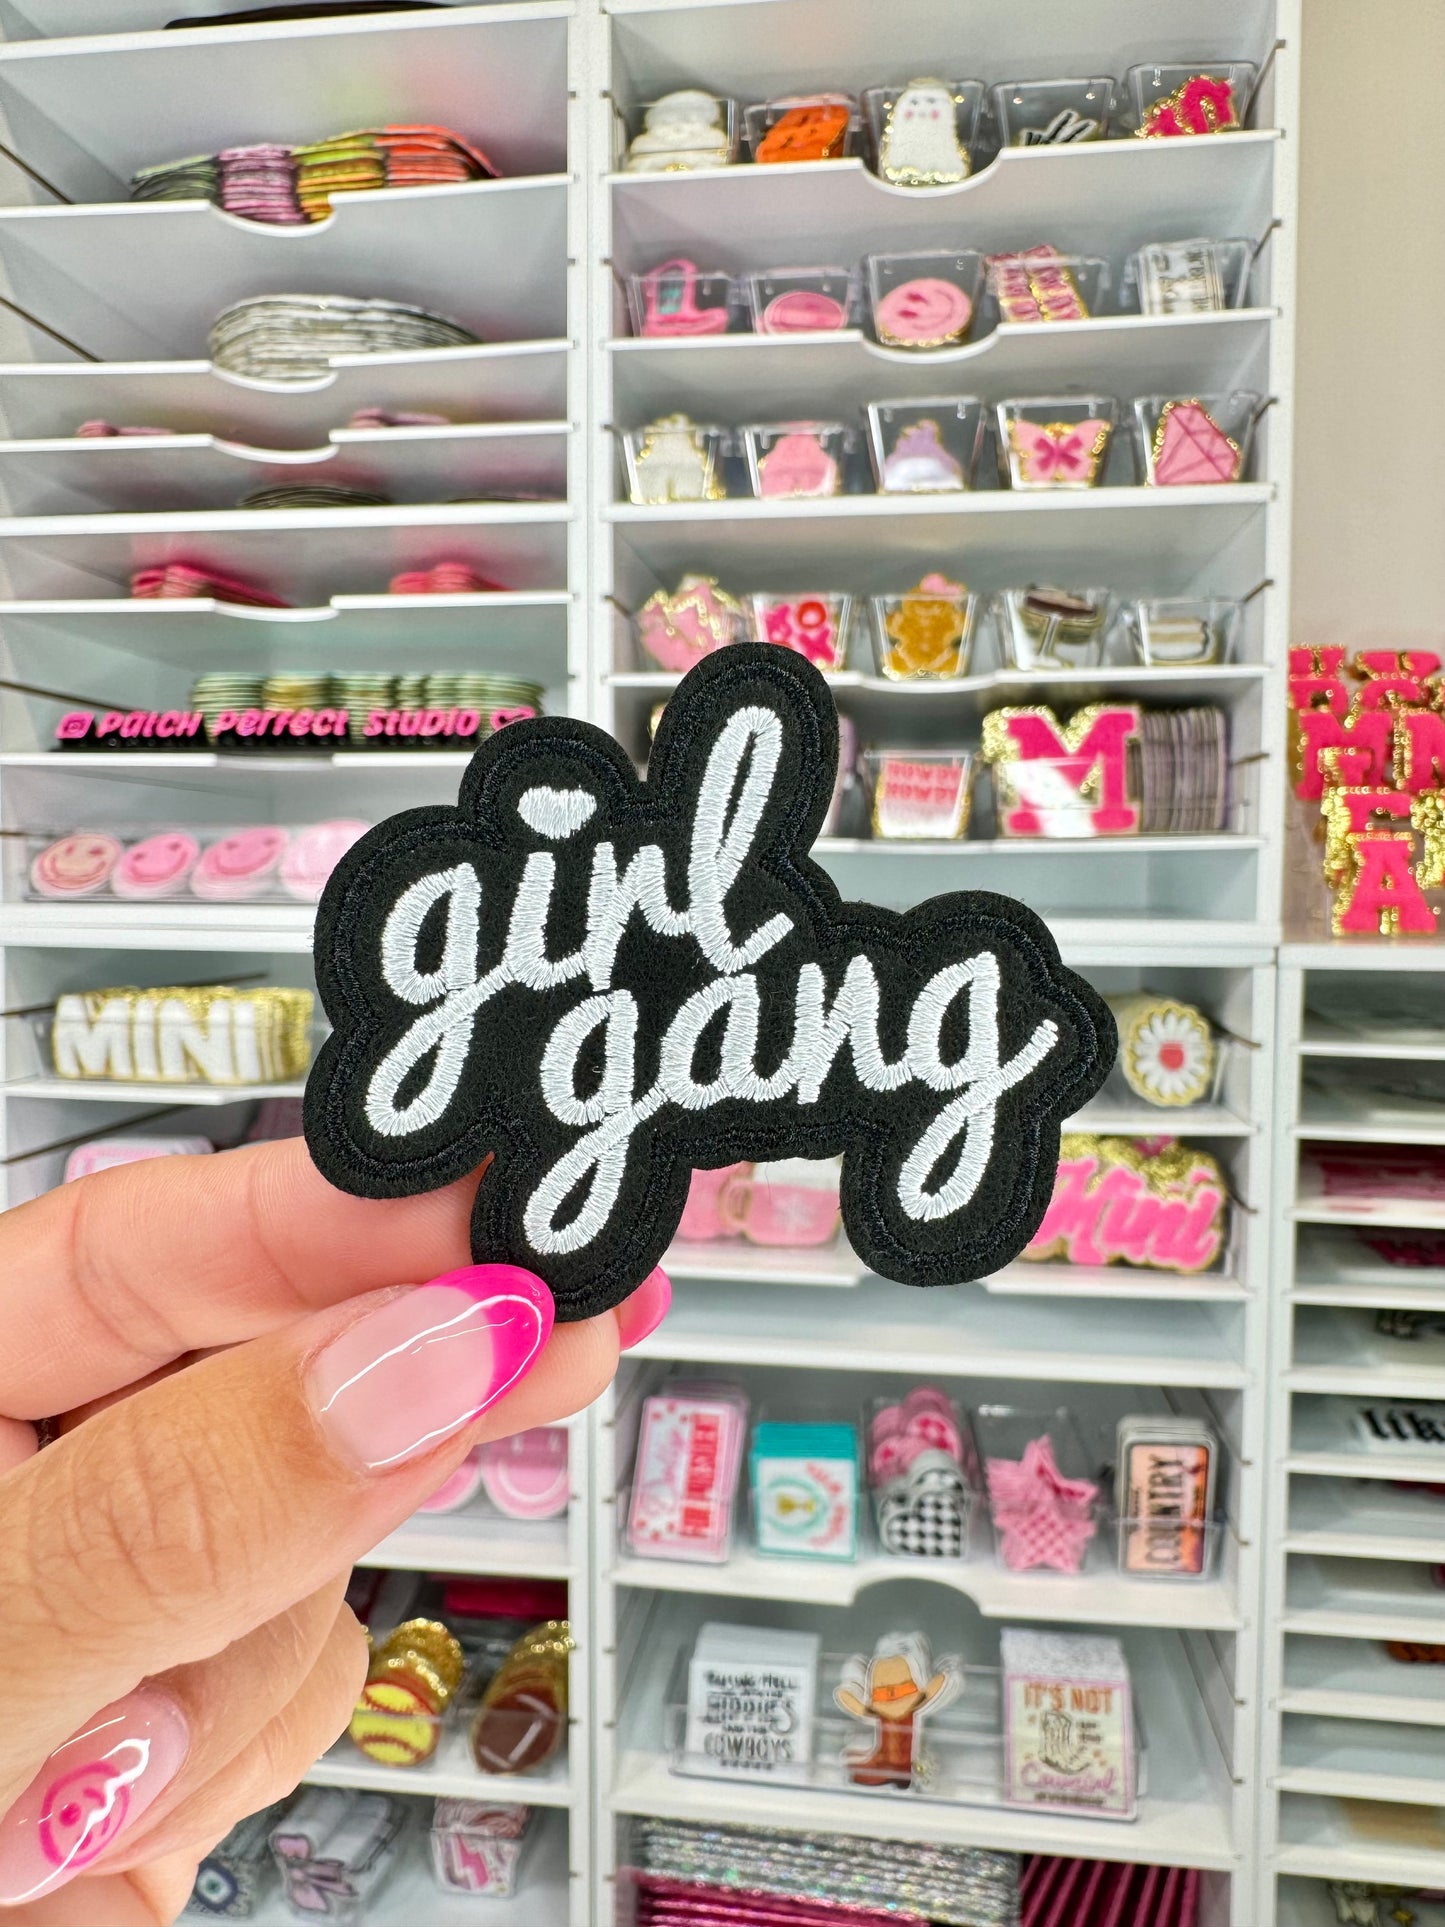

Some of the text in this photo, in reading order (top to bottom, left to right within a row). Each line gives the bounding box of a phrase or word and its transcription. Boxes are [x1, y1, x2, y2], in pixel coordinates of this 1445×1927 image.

[1006, 711, 1136, 832] M
[366, 705, 793, 1137] girl
[1340, 840, 1438, 933] A
[56, 994, 262, 1082] MINI
[522, 950, 1059, 1256] gang
[1360, 1407, 1445, 1443] lik
[1023, 1681, 1113, 1714] IT'S NOT
